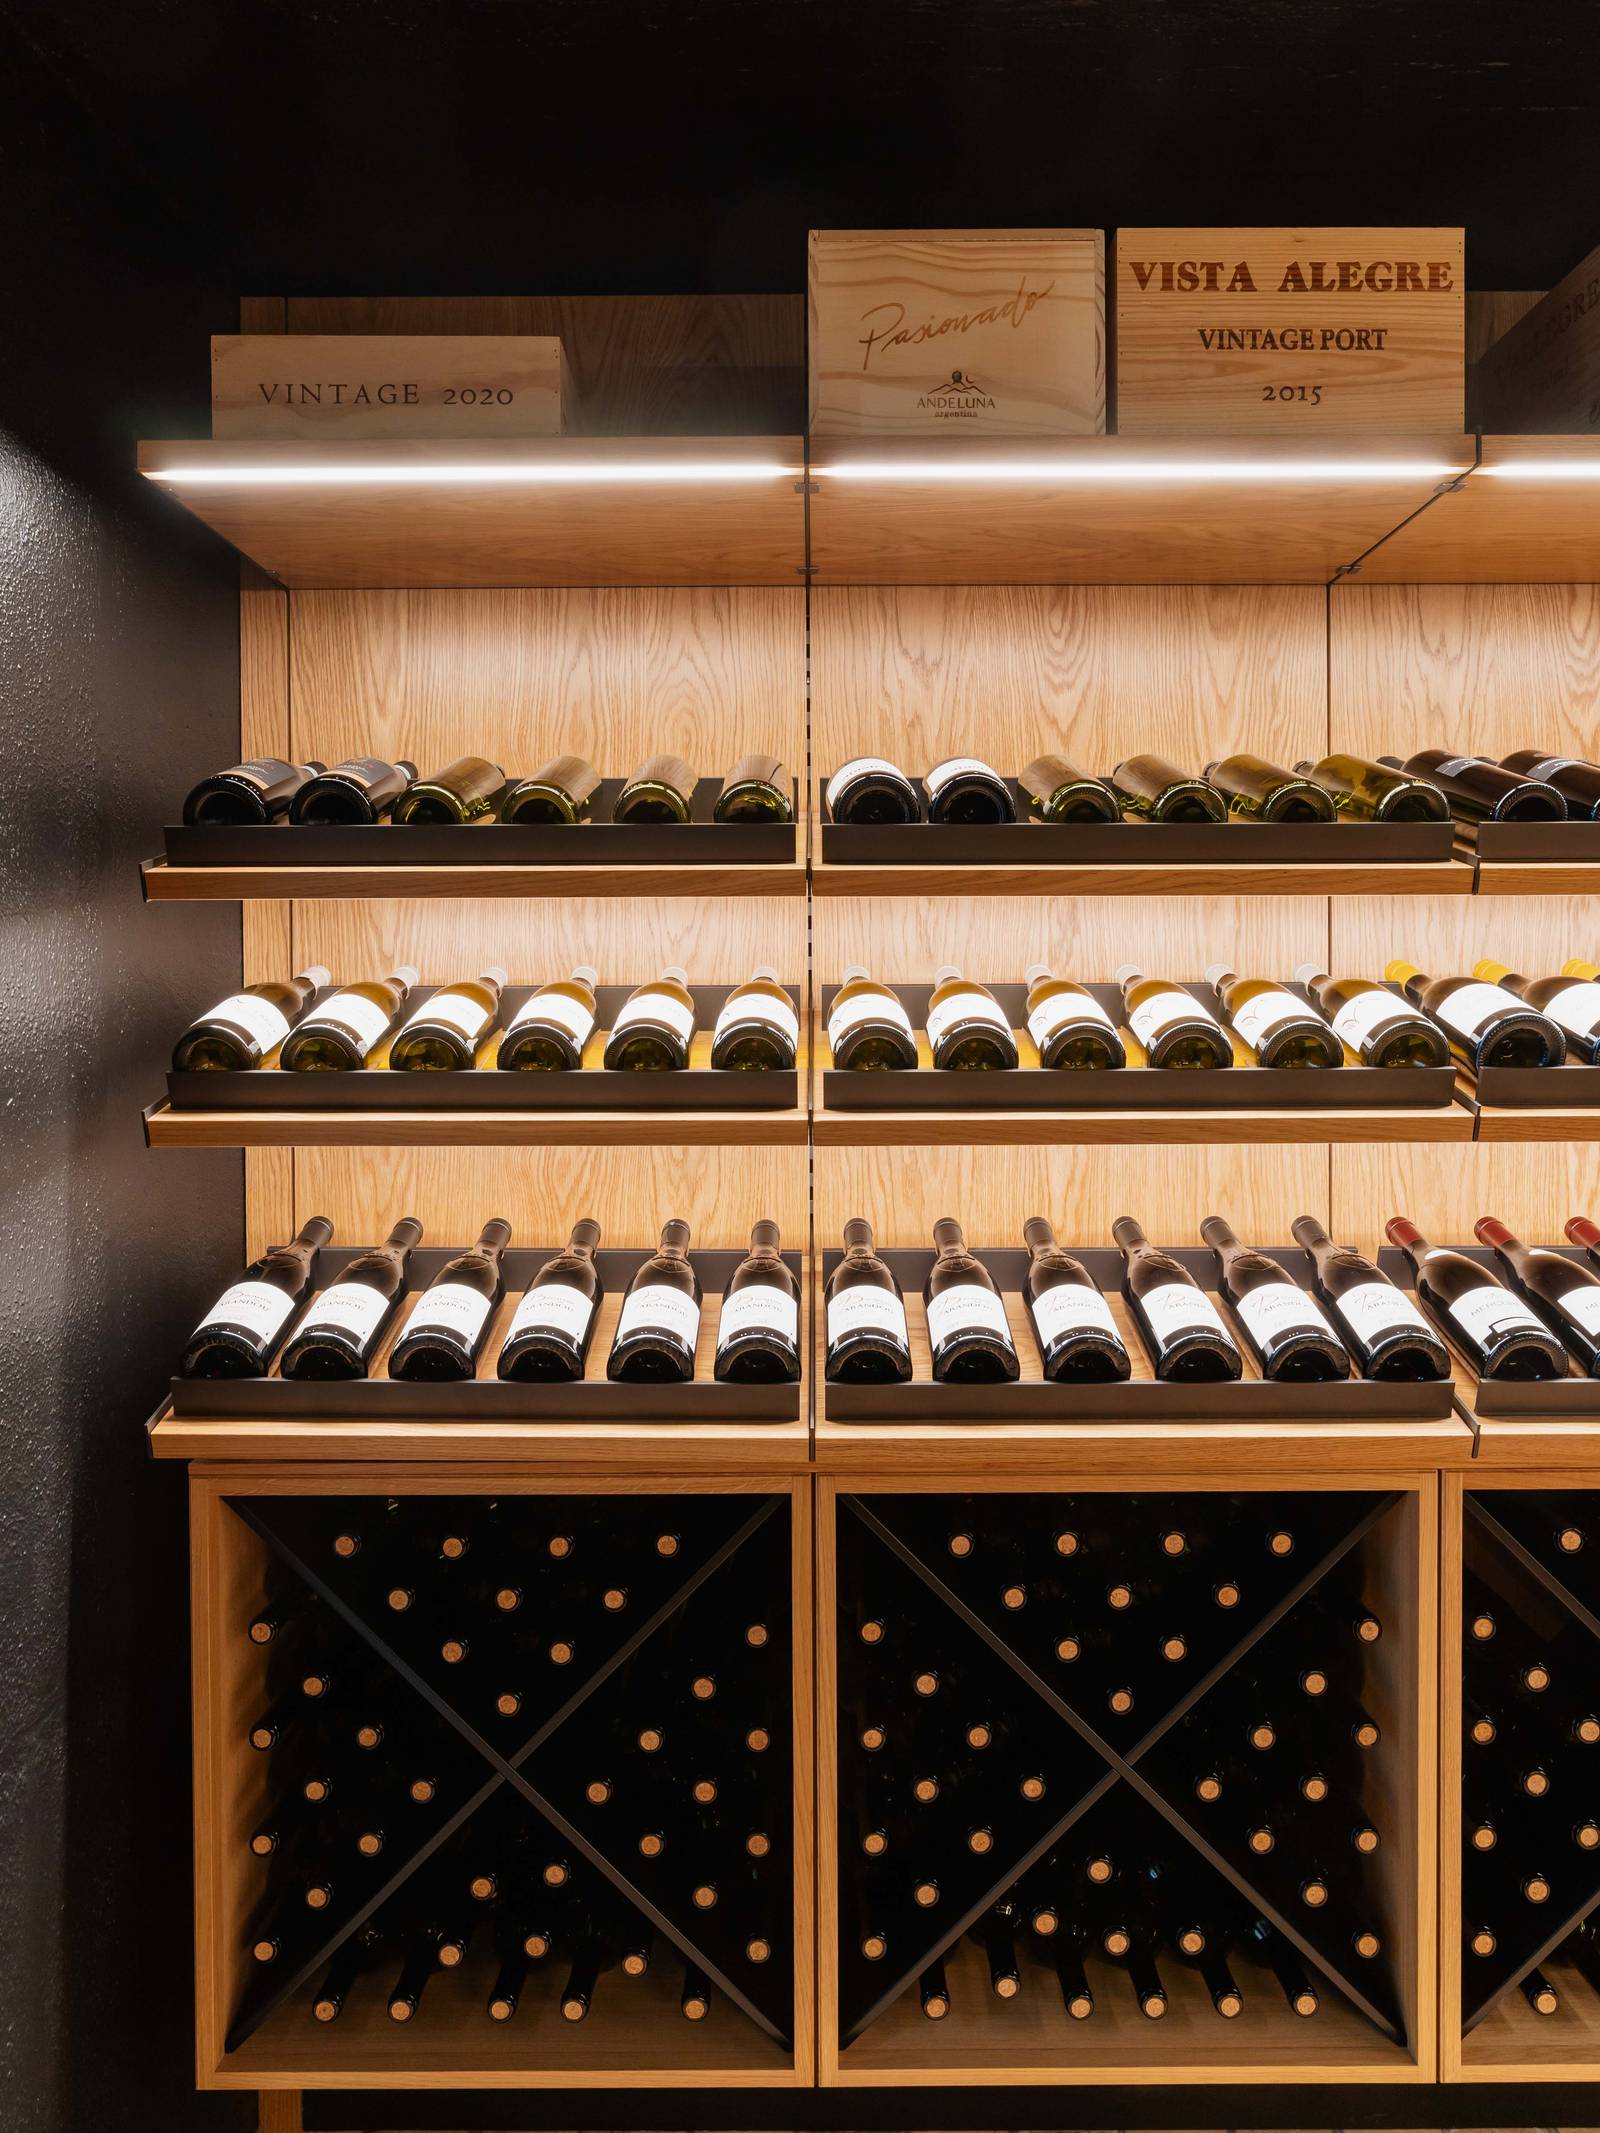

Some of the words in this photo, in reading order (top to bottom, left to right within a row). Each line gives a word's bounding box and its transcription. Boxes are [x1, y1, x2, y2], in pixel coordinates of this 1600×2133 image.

[1128, 260, 1258, 293] VISTA
[1277, 260, 1454, 293] ALEGRE
[858, 275, 1056, 371] Pasionado
[1198, 328, 1314, 351] VINTAGE
[1320, 328, 1388, 351] PORT
[258, 383, 421, 405] VINTAGE
[443, 388, 515, 406] 2020
[916, 397, 996, 409] ANDELUNA
[1262, 385, 1323, 406] 2015
